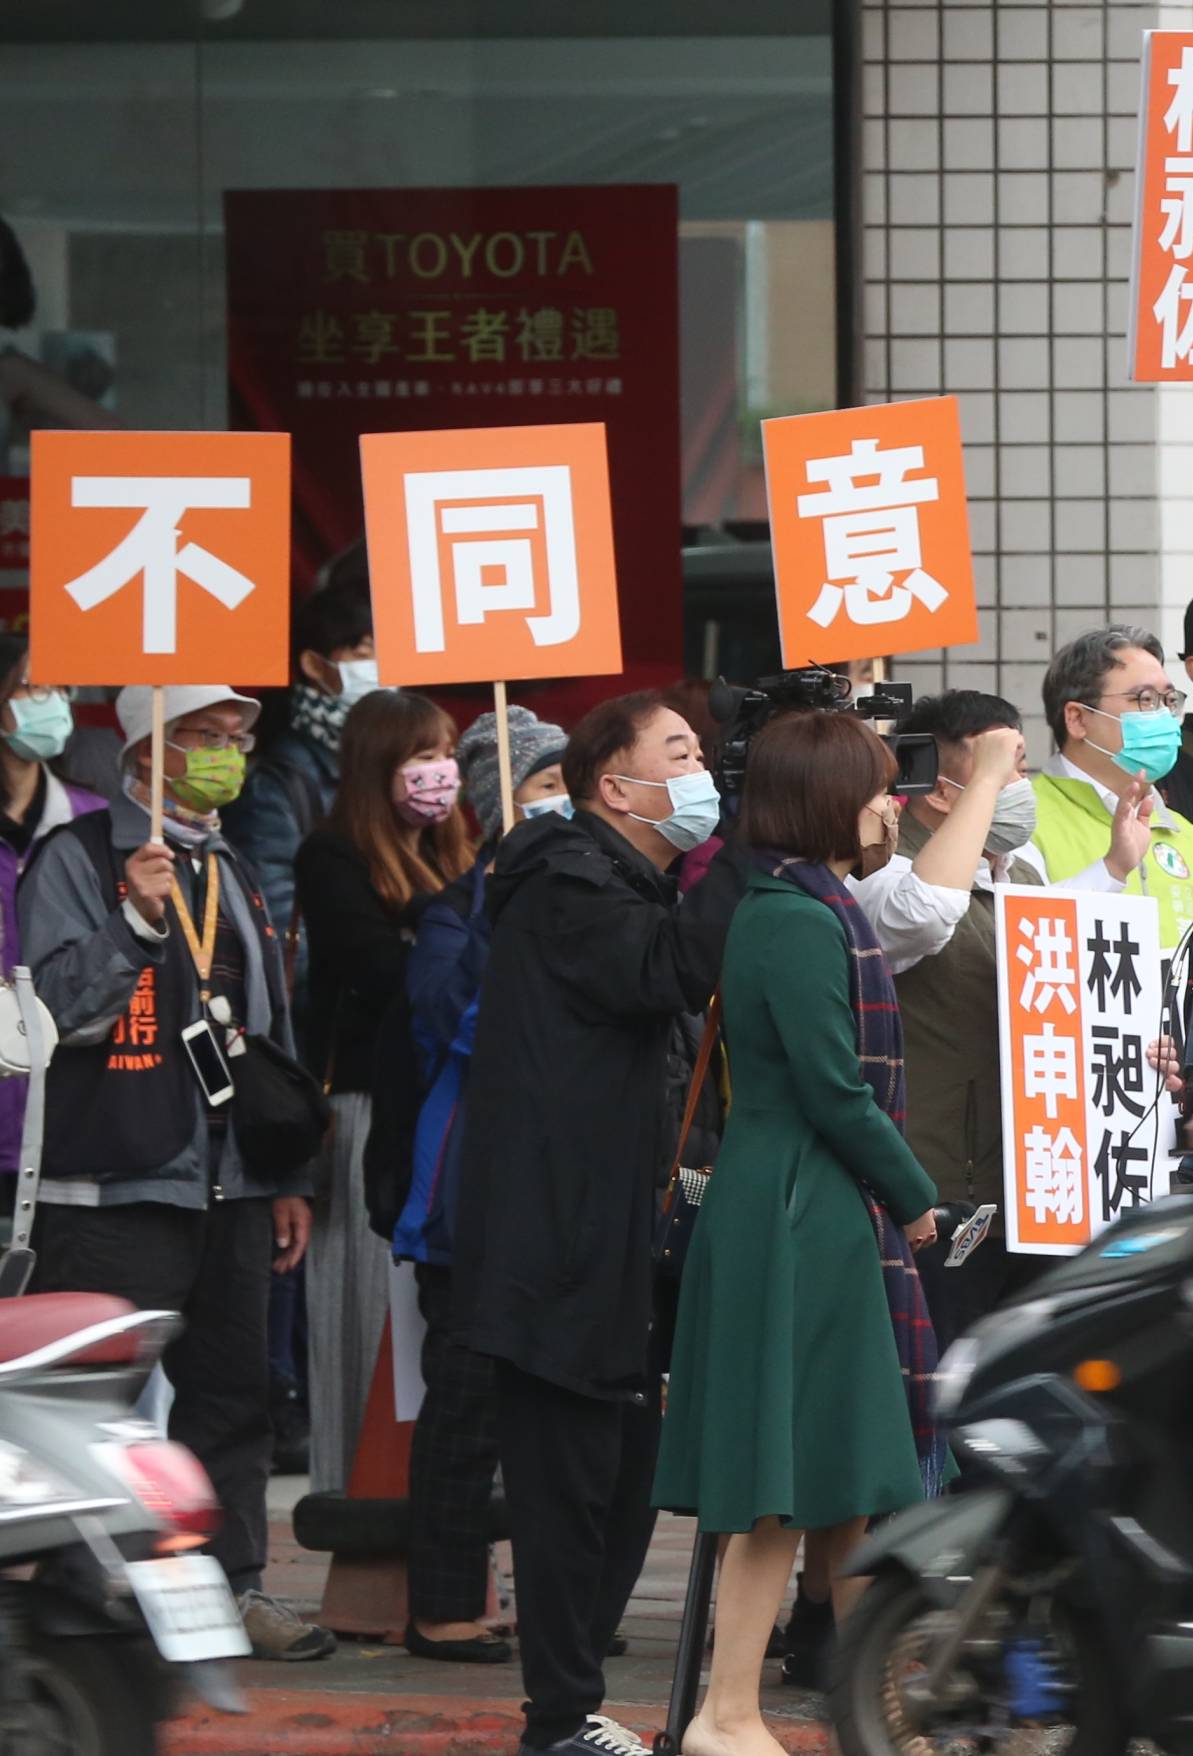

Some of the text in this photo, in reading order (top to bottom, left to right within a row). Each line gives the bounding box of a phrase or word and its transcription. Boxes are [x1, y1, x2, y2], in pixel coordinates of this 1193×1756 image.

[64, 475, 256, 654] 不
[403, 465, 581, 653] 同
[796, 438, 950, 629] 意
[1014, 916, 1084, 1226] 洪申翰
[1087, 918, 1150, 1222] 林昶佐
